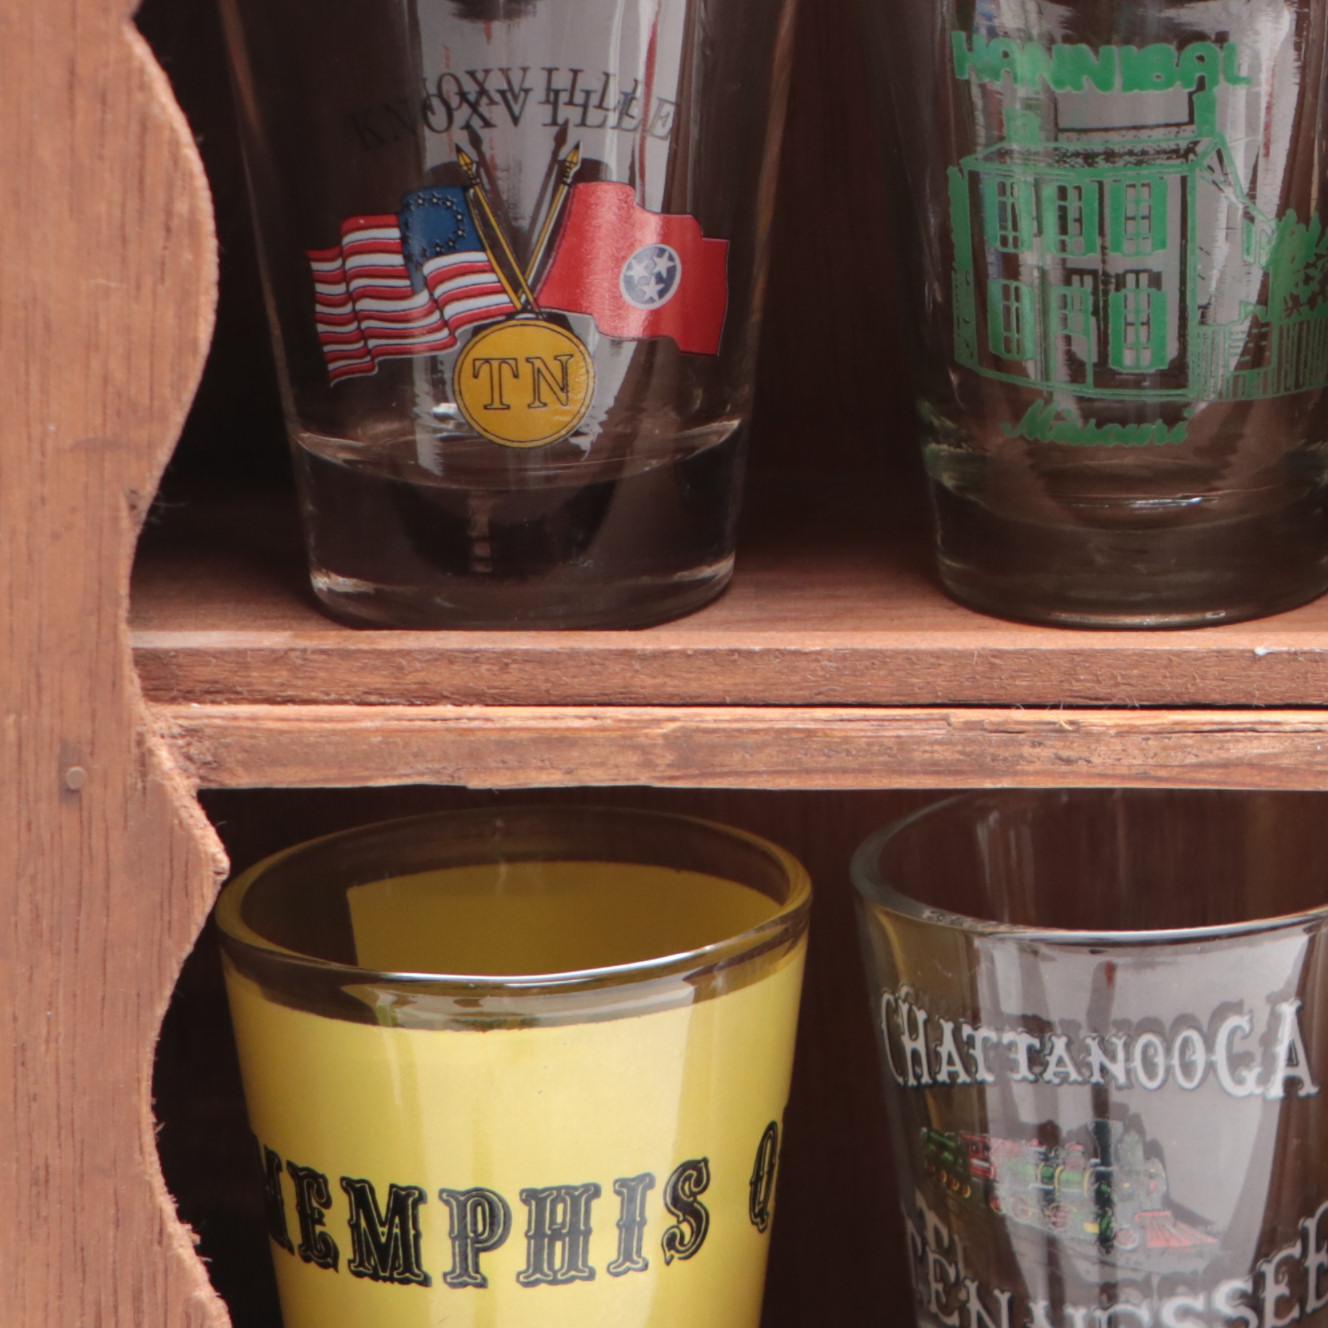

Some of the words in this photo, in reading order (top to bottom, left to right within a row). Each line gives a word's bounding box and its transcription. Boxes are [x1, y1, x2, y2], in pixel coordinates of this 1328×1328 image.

[347, 86, 680, 153] KNOXVILLE
[471, 354, 576, 412] TN
[880, 986, 1320, 1101] CHATTANOOGA
